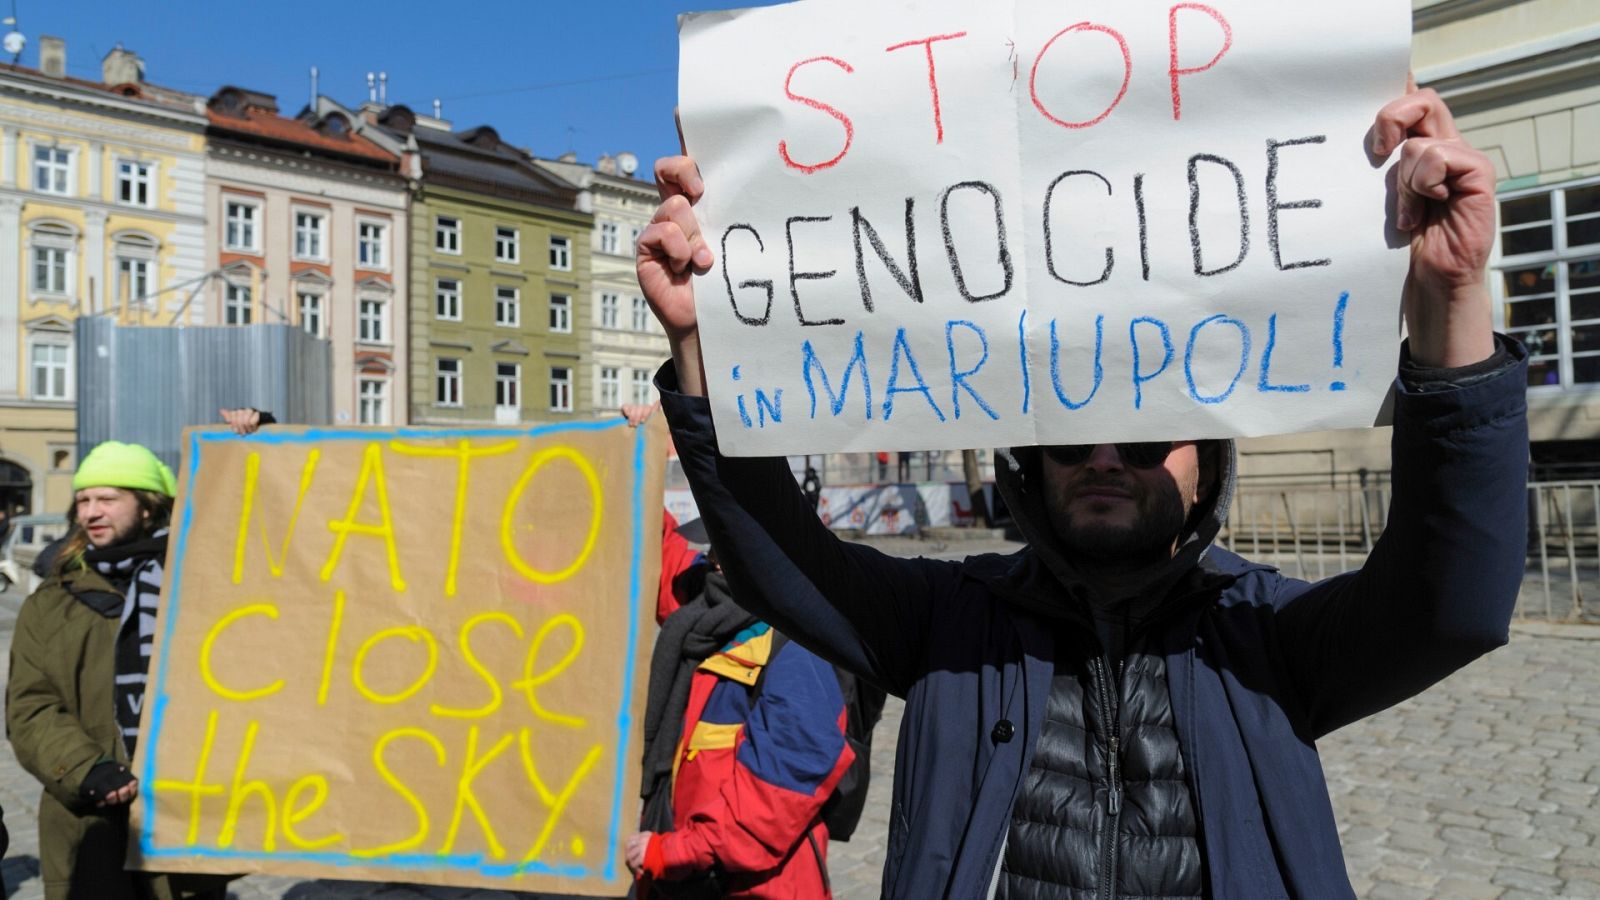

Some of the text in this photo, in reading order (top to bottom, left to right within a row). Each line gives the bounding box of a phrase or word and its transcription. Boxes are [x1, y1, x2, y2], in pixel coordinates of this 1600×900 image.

[778, 3, 1233, 174] STOP
[721, 135, 1331, 326] GENOCIDE
[801, 292, 1350, 421] MARIUPOL!
[233, 440, 603, 596] NATO
[153, 710, 345, 851] the
